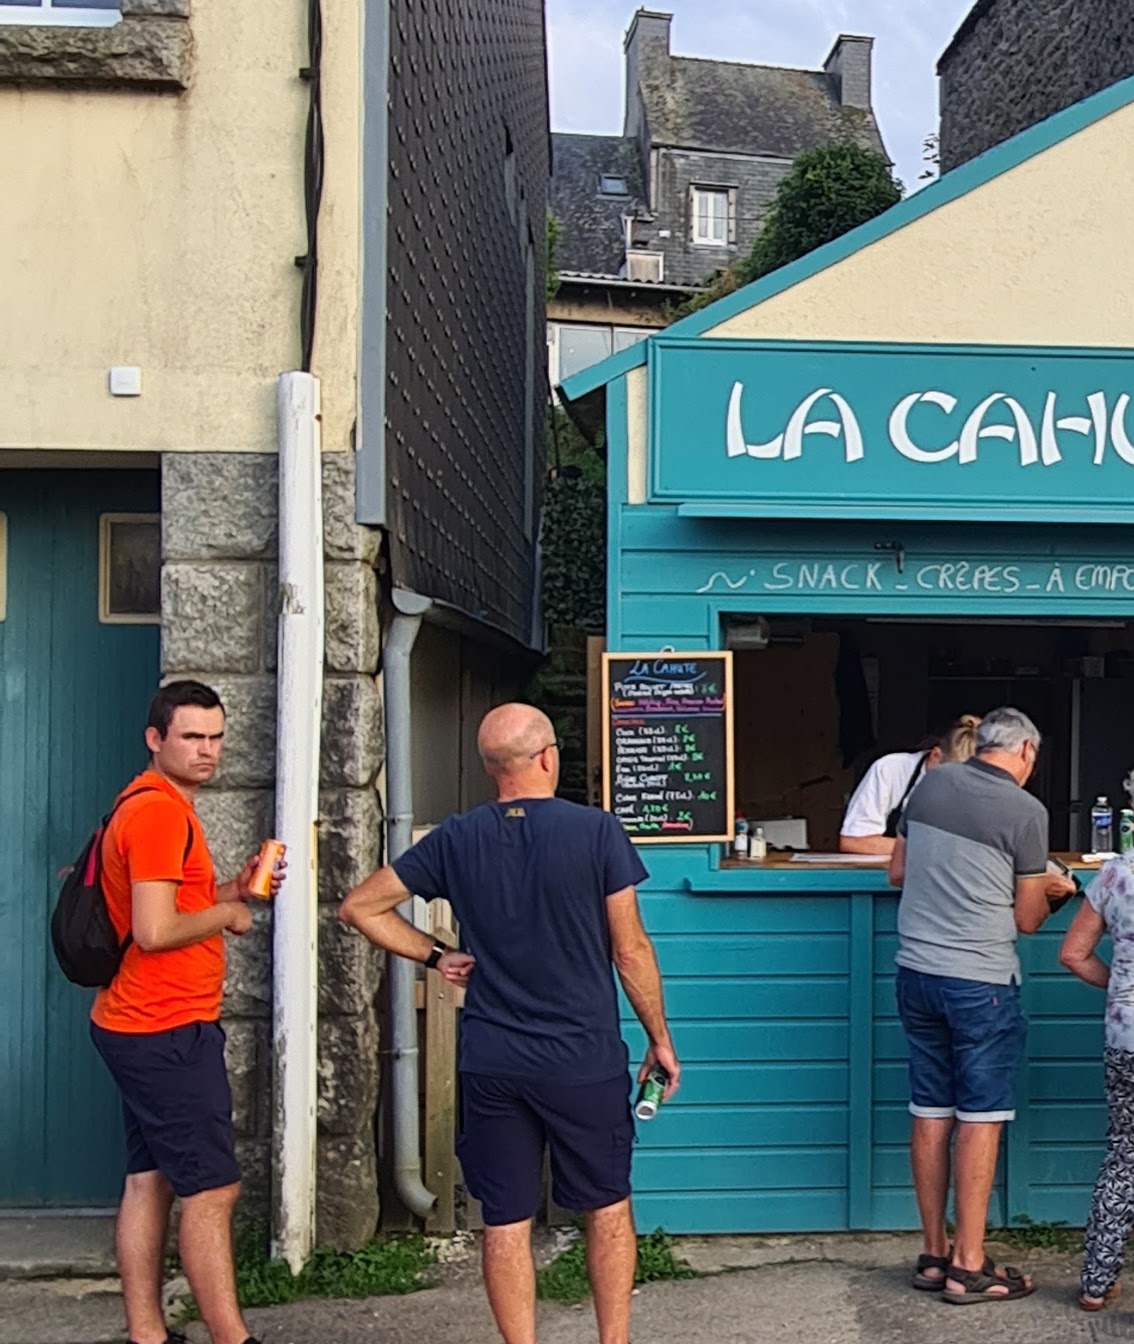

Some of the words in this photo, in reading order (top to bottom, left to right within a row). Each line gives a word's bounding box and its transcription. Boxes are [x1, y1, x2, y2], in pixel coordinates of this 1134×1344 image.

[726, 380, 865, 463] LA
[763, 562, 883, 591] SNACK
[1045, 561, 1065, 593] À
